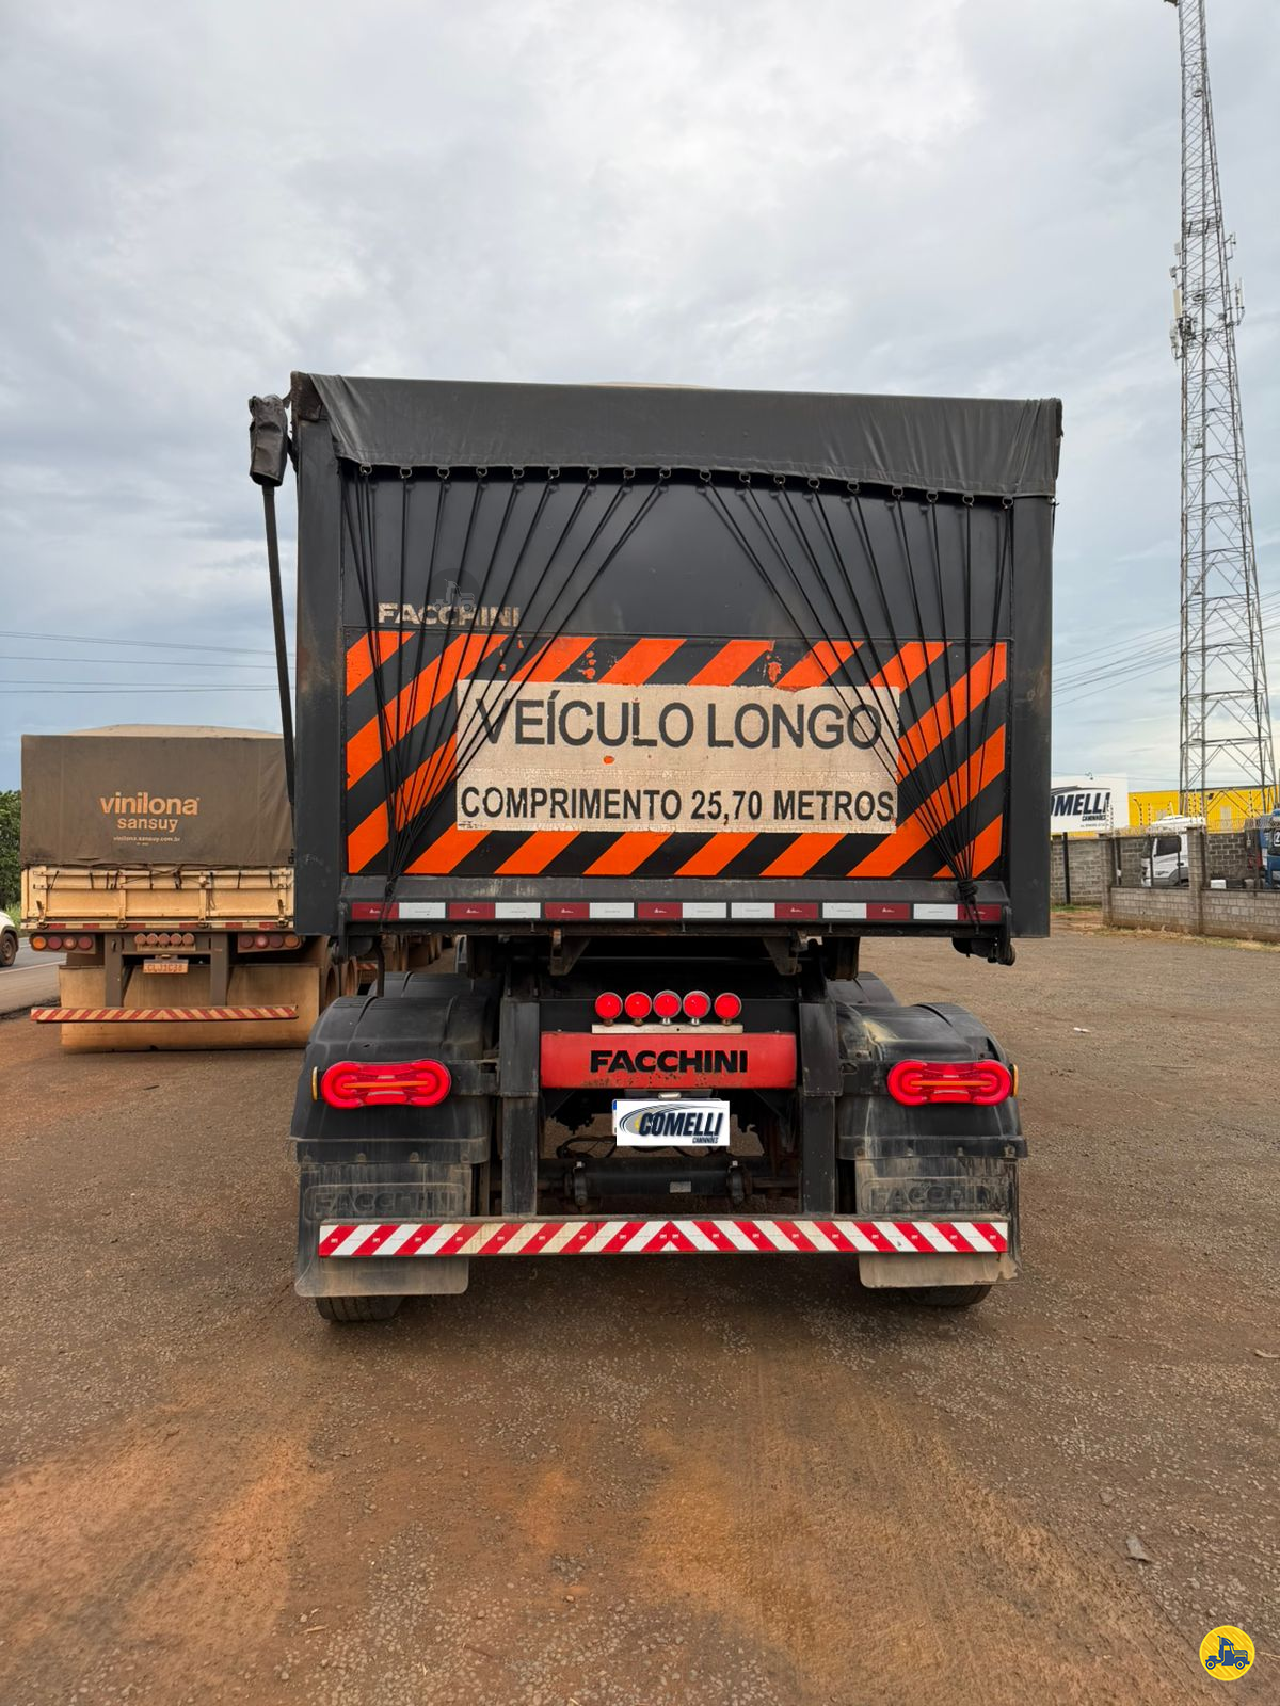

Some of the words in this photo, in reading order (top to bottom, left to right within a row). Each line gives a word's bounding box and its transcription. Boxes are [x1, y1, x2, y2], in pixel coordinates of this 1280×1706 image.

[378, 602, 520, 627] FACCHINI
[476, 690, 694, 748] VEÍCULO
[707, 703, 882, 750] LONGO
[100, 791, 198, 815] vinilona
[461, 786, 682, 820] COMPRIMENTO
[691, 789, 762, 825] 25,70
[773, 790, 894, 821] METROS
[117, 818, 178, 833] sansuy
[590, 1050, 748, 1072] FACCHINI
